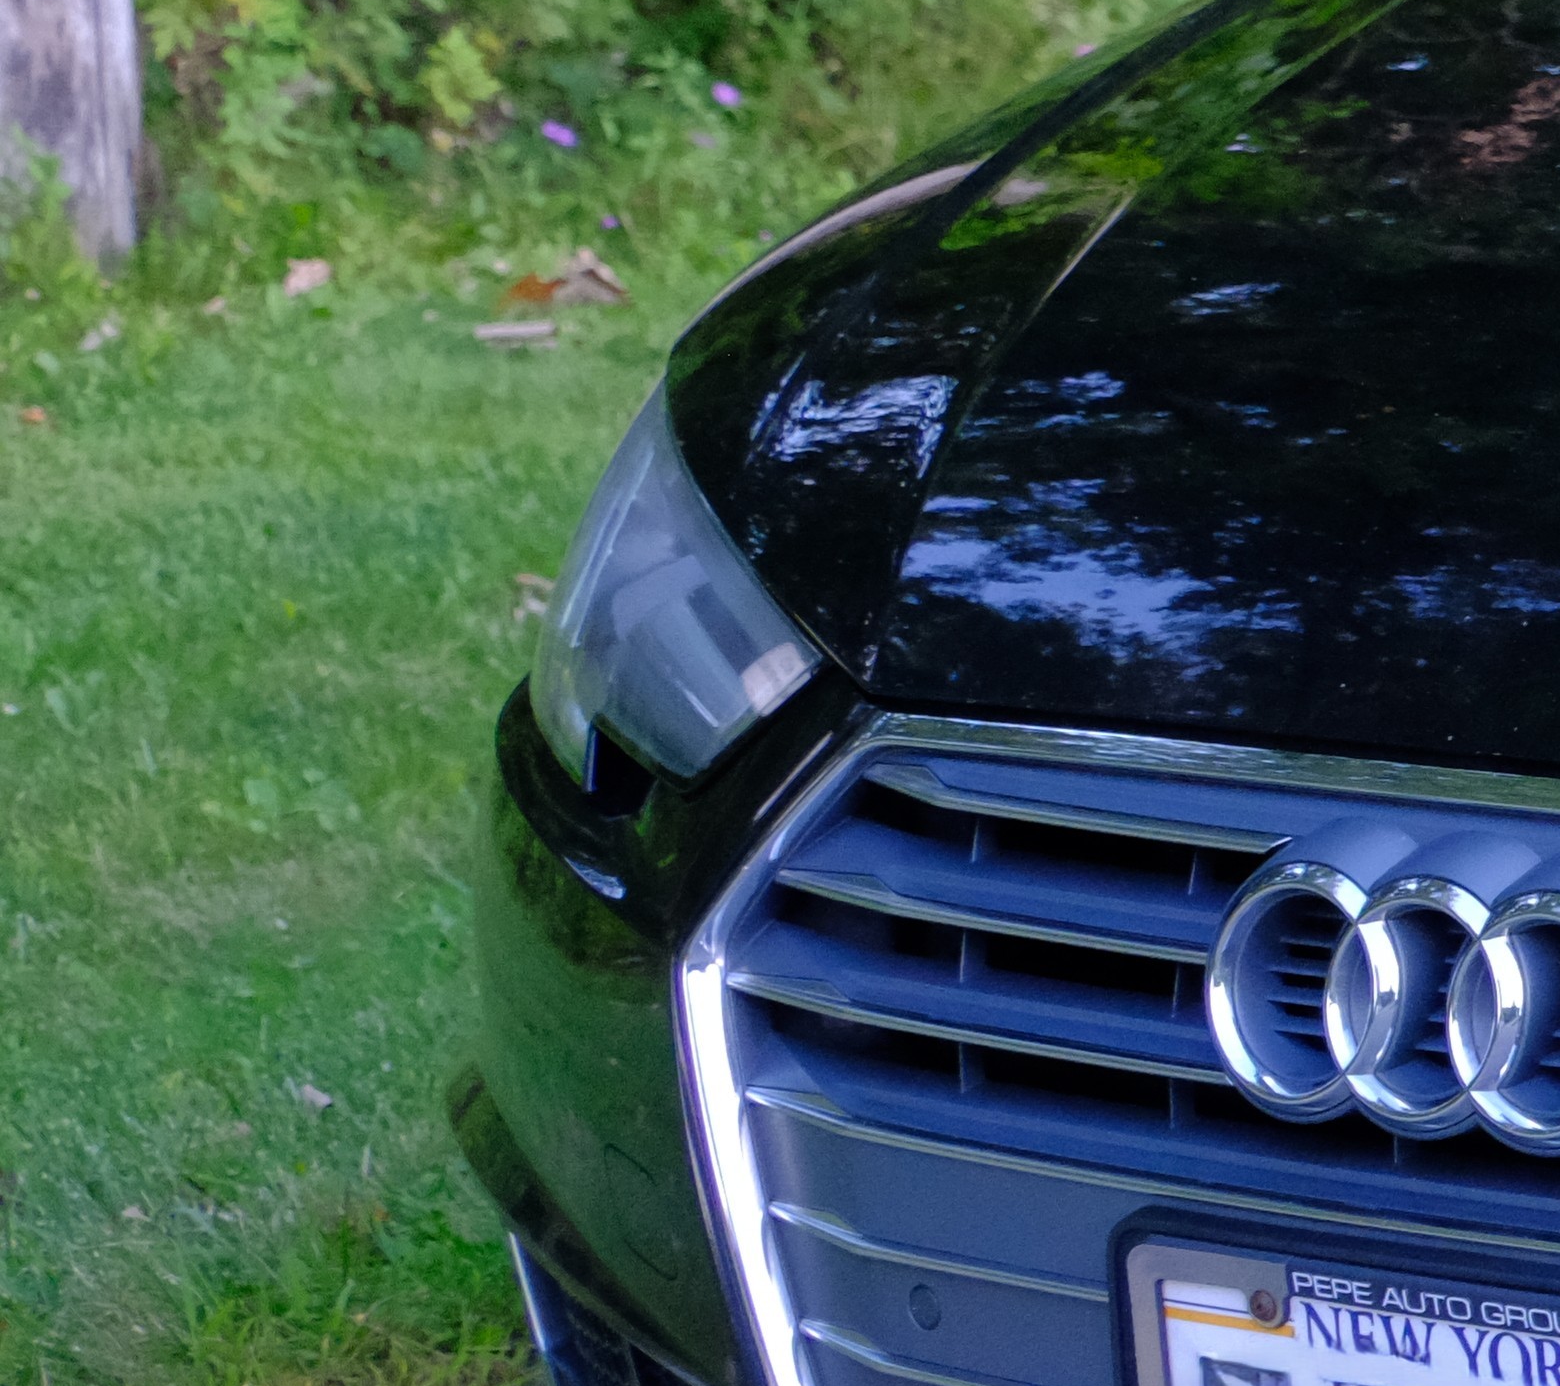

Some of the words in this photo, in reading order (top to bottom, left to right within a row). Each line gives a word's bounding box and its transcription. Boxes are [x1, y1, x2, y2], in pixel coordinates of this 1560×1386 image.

[1292, 1272, 1373, 1306] PEPE
[1382, 1287, 1472, 1321] AUTO
[1300, 1302, 1438, 1366] NEW
